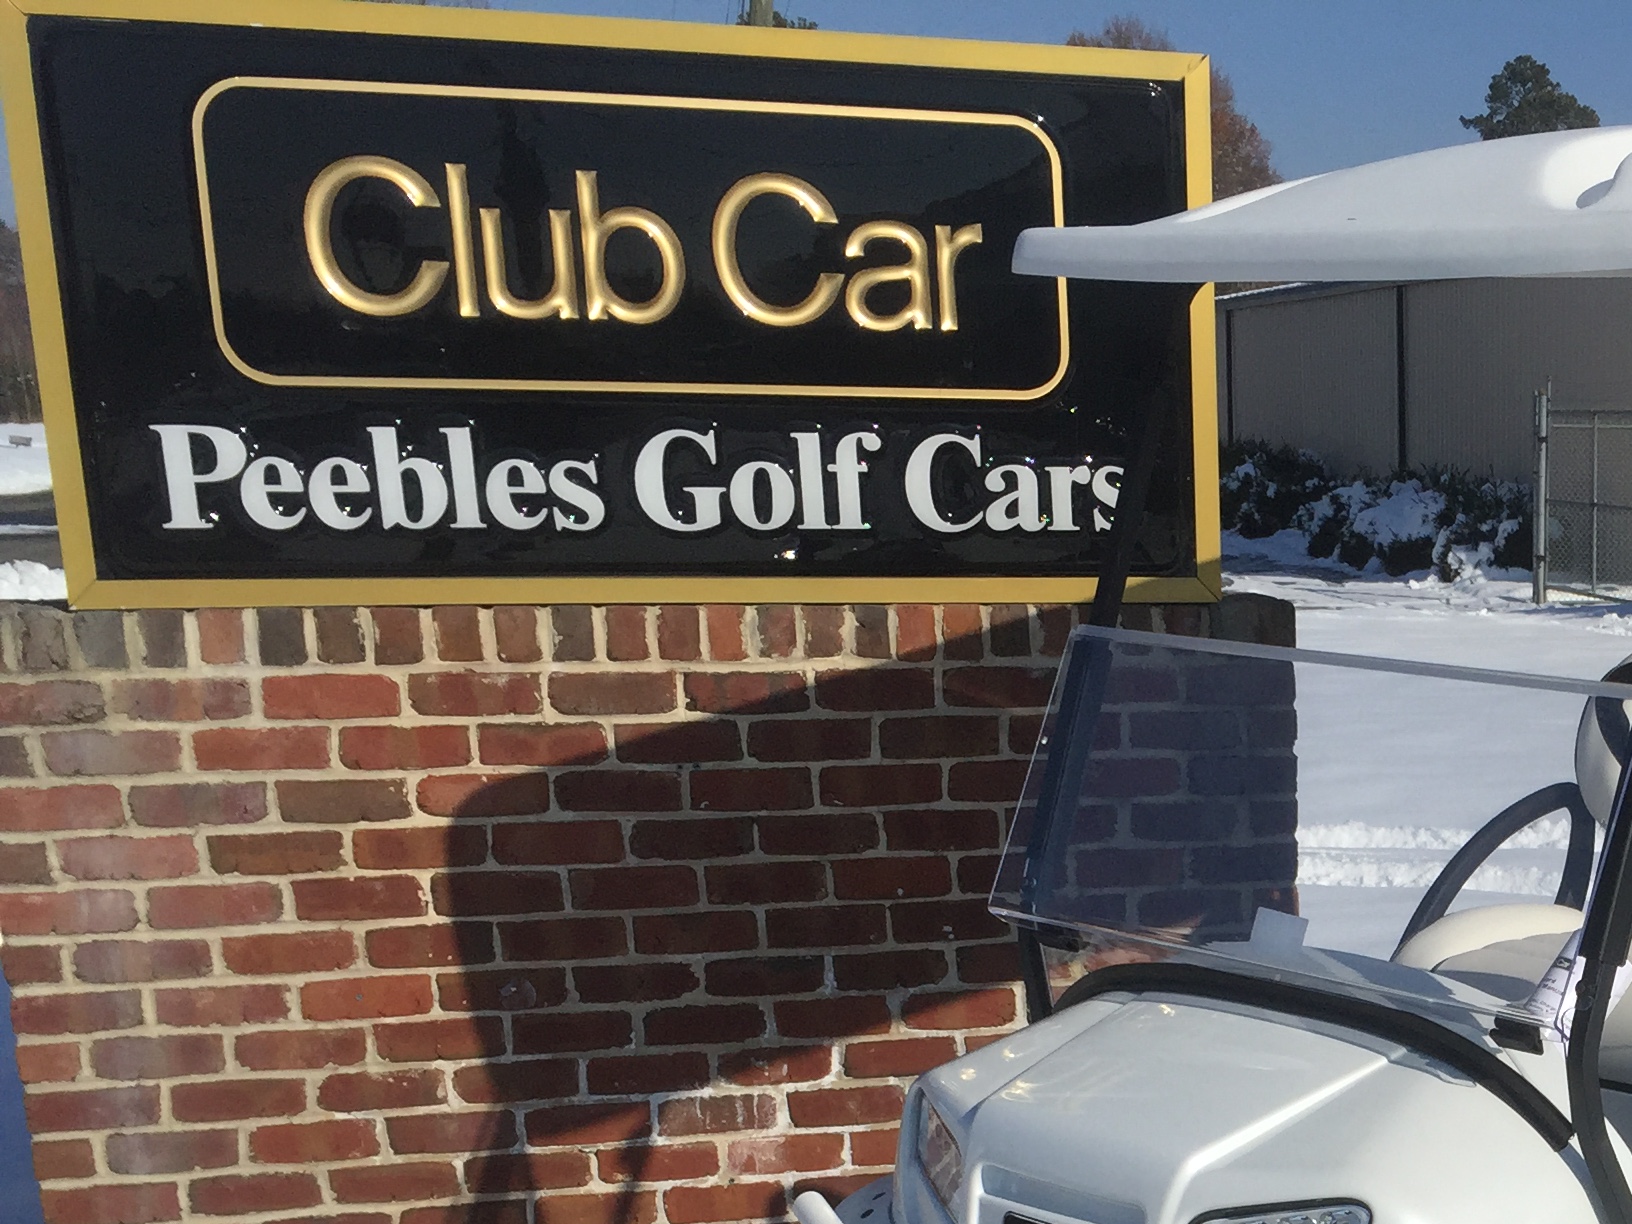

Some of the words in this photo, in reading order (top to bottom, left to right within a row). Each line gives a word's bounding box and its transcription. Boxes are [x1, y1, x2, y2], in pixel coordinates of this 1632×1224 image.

[303, 154, 686, 324] Club
[712, 172, 982, 331] Car
[148, 423, 605, 531] Peebles
[634, 428, 881, 531] Golf
[904, 433, 1125, 533] Cars
